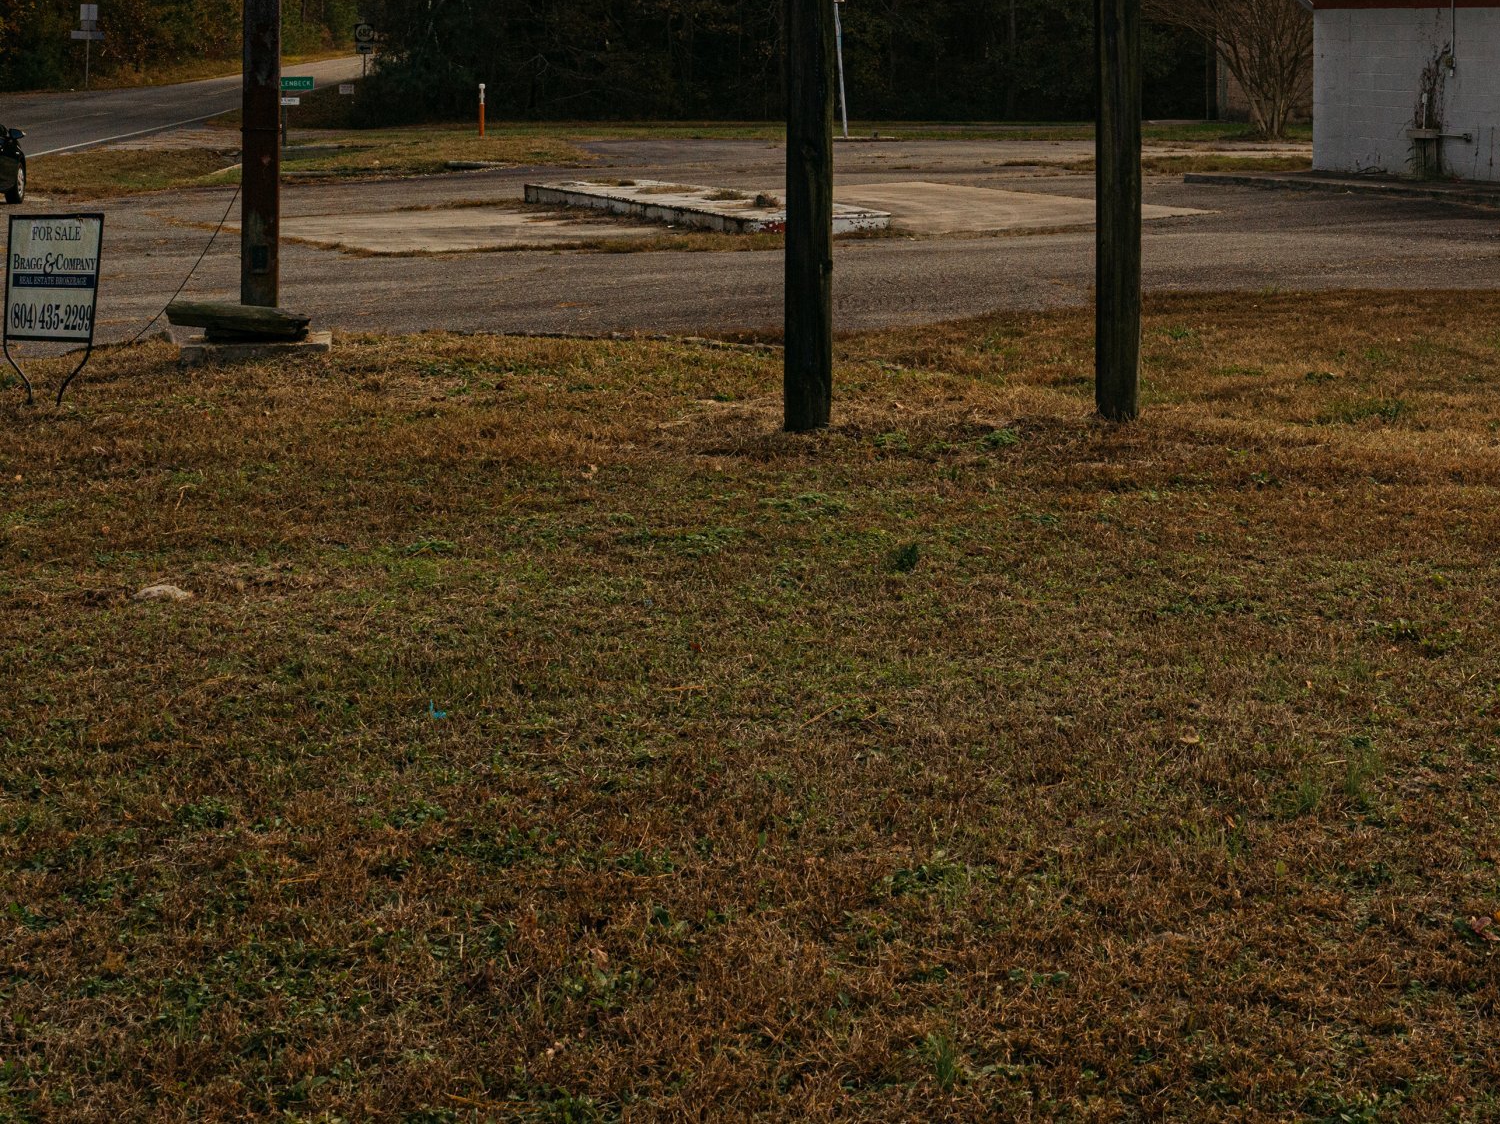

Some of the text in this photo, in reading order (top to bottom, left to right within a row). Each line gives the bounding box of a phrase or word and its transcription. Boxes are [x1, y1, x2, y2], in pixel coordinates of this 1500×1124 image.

[32, 226, 82, 241] FOR SALE
[19, 276, 87, 286] REAL ESTATE BROKERAGE
[10, 302, 92, 332] (804) 435-2299
